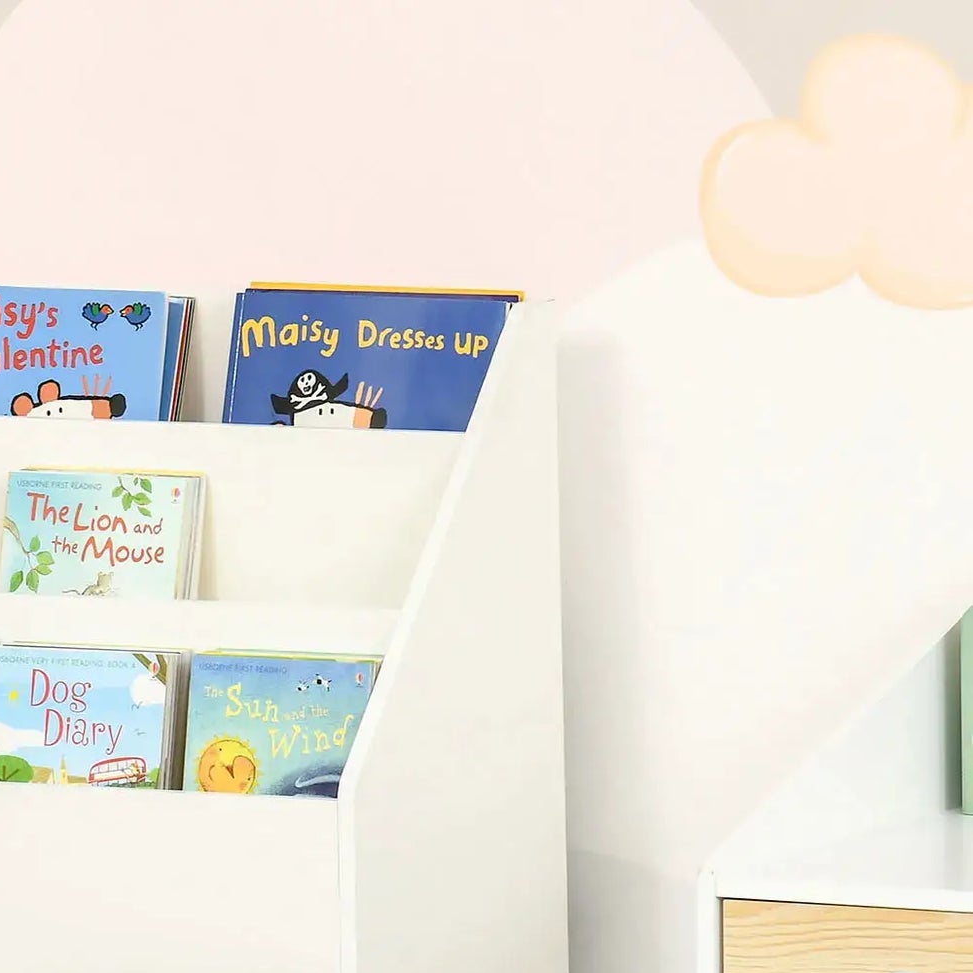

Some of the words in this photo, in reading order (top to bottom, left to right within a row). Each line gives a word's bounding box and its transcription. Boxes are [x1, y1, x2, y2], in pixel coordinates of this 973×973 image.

[241, 314, 339, 358] Maisy
[357, 319, 445, 351] Dresses
[26, 491, 70, 526] The
[73, 502, 128, 534] Lion
[133, 517, 164, 535] and
[51, 535, 78, 554] the
[80, 535, 165, 567] Mouse
[30, 669, 92, 713] Dog
[203, 685, 224, 698] The
[226, 682, 279, 723] Sun
[43, 708, 123, 756] Diary
[268, 714, 355, 759] Wind
